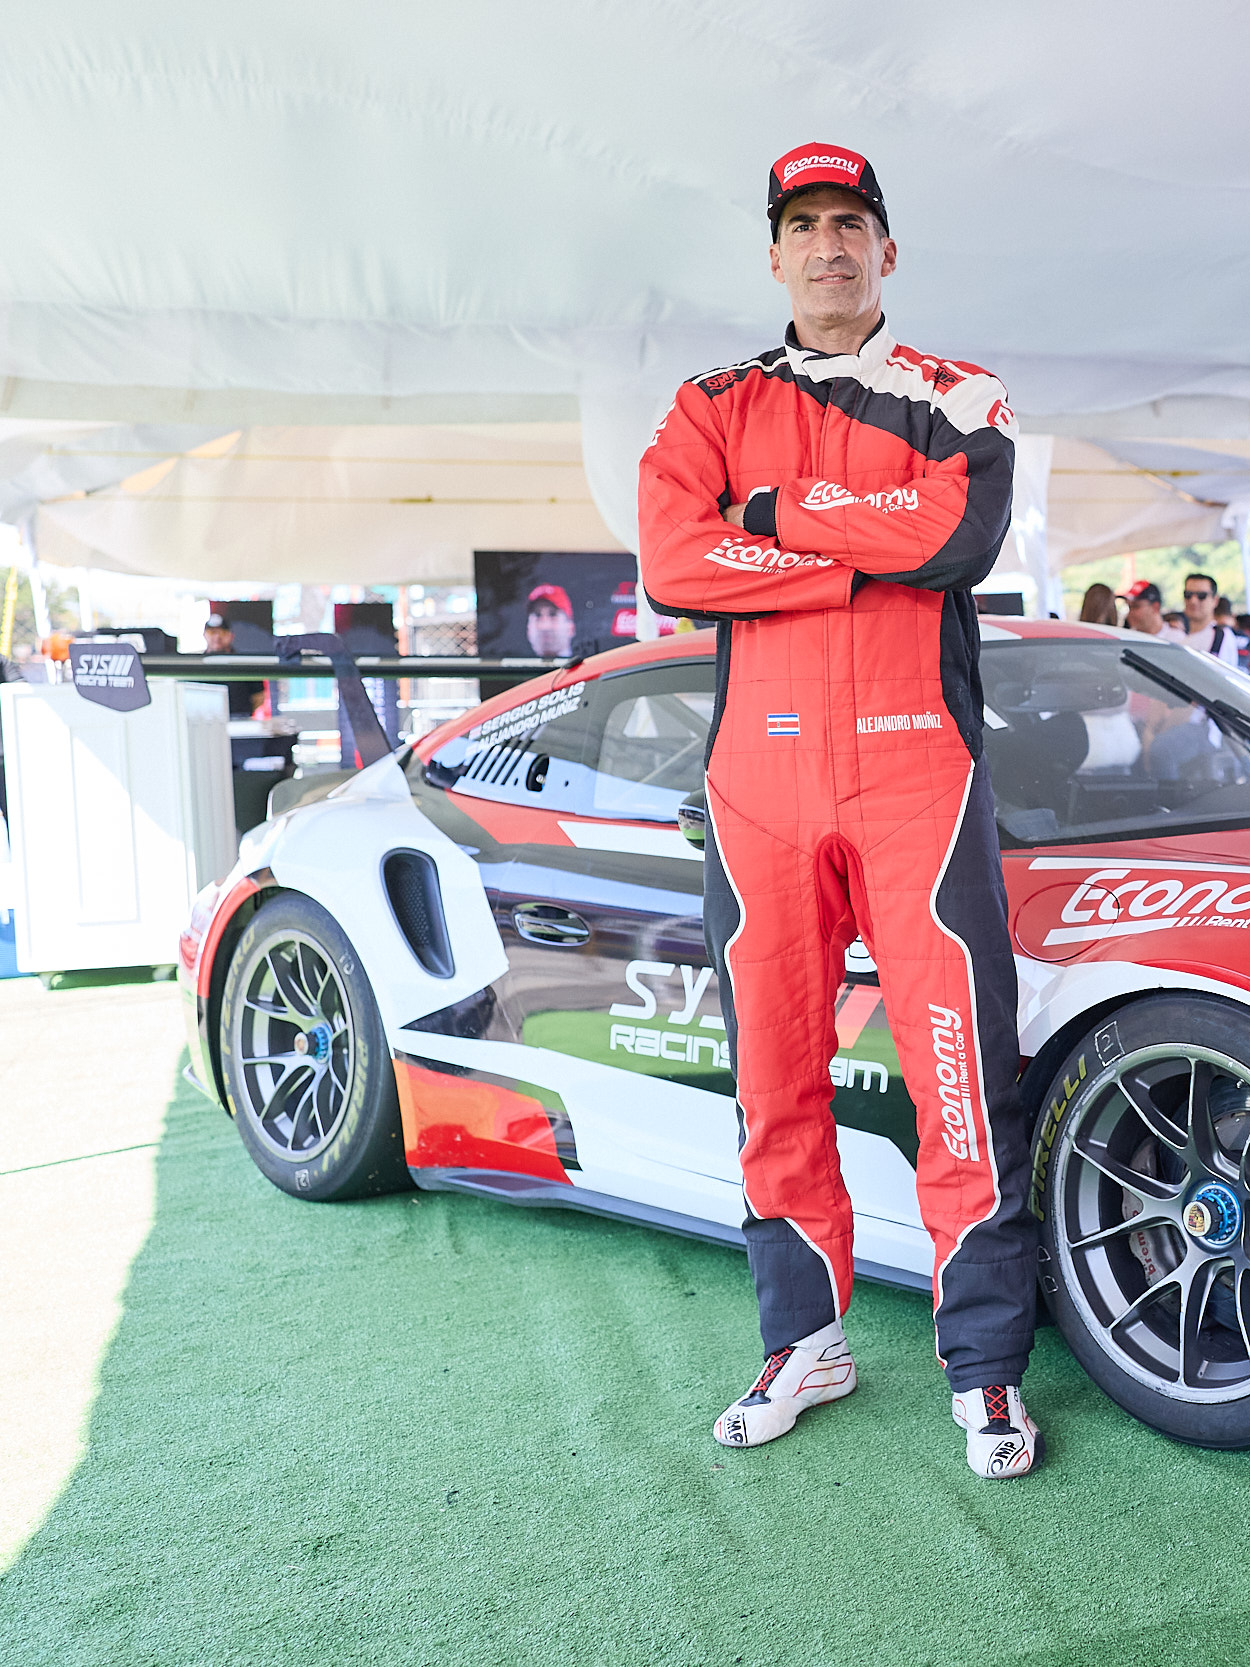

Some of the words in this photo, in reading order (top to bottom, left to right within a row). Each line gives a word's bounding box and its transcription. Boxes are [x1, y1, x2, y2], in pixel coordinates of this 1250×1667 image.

[783, 155, 859, 178] Economy
[804, 480, 919, 511] Ecoomy
[712, 537, 834, 569] Econo
[481, 700, 537, 735] SERGIO
[537, 681, 586, 710] SOLIS
[856, 714, 910, 734] ALEJANDRO
[911, 711, 943, 730] MUÑIZ
[479, 714, 540, 750] ALEJANDRO
[955, 1031, 965, 1050] Car
[958, 1052, 966, 1060] a
[928, 1003, 969, 1160] Economy
[959, 1061, 970, 1084] Rent
[1027, 1053, 1087, 1222] PIRELLI
[727, 1414, 744, 1444] OMP
[991, 1441, 1017, 1475] OMP
